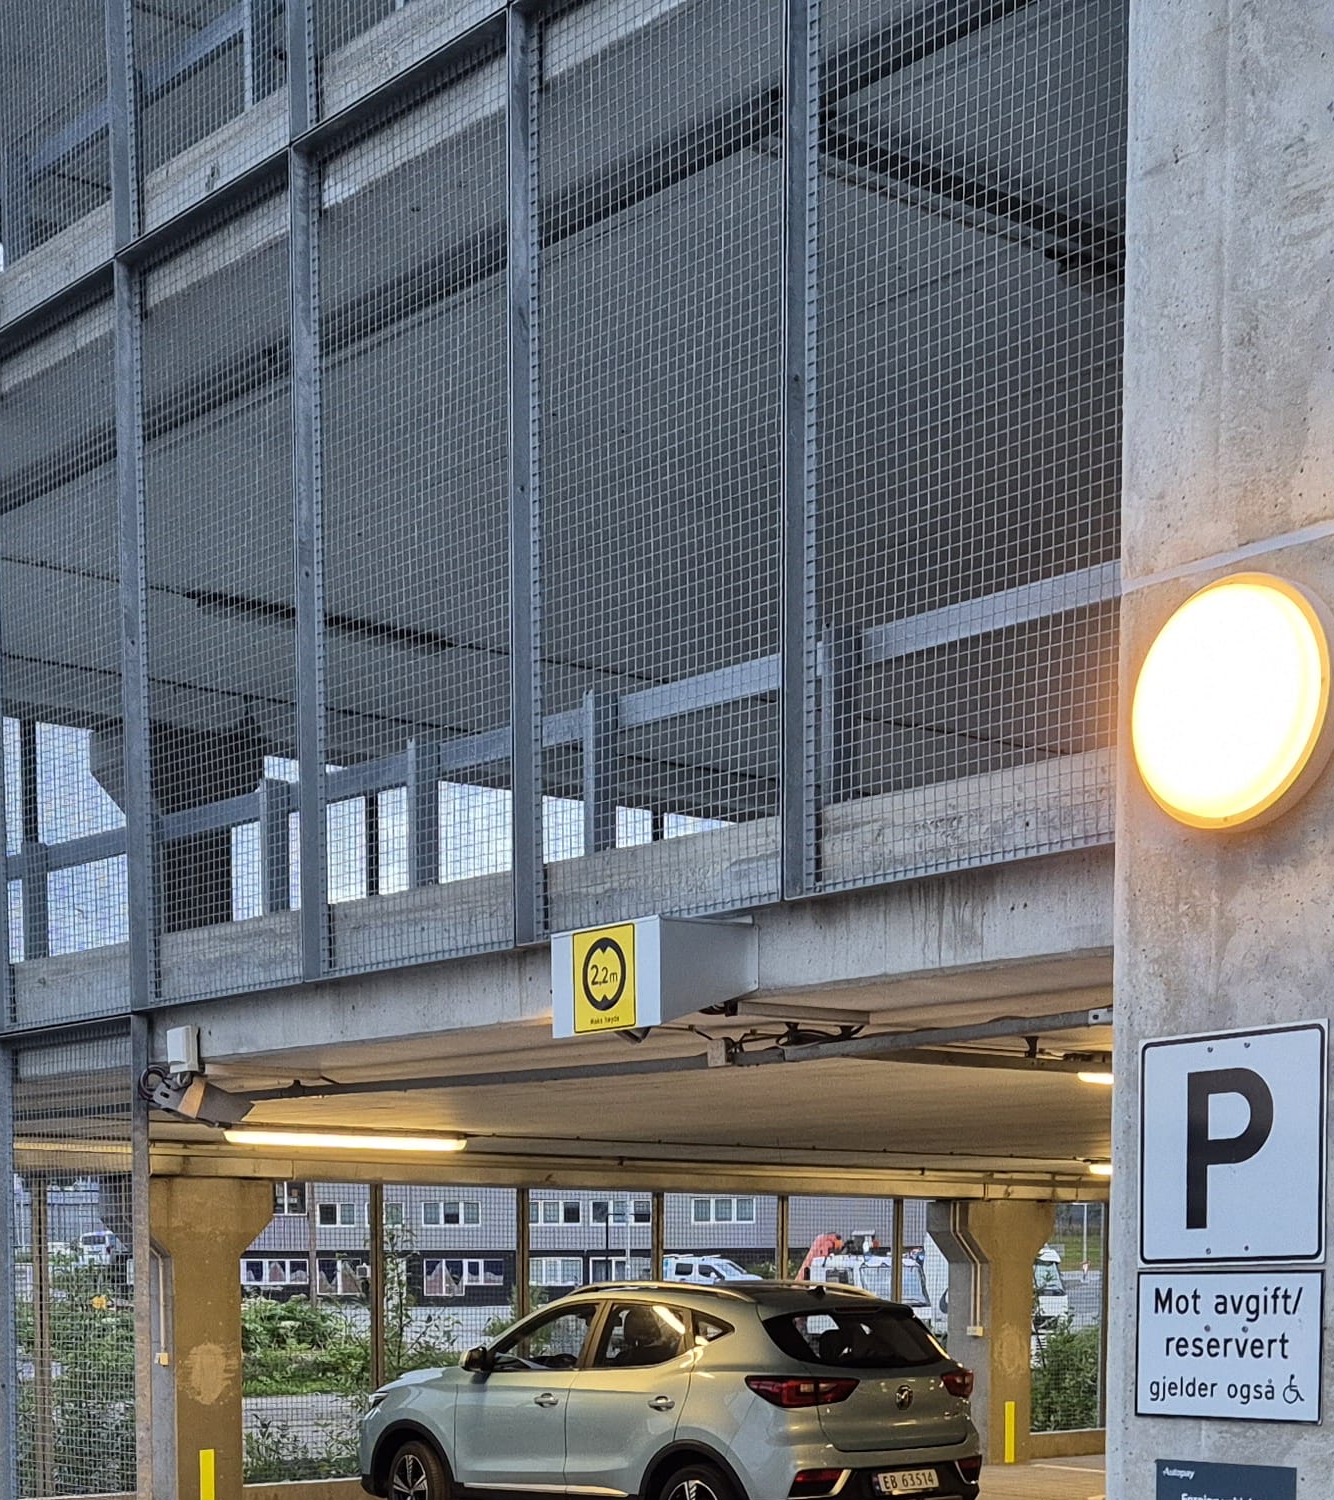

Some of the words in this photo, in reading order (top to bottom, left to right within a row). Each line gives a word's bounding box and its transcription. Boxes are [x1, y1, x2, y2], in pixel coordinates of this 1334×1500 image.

[1186, 1067, 1274, 1230] P
[1154, 1287, 1201, 1316] Mot
[1214, 1286, 1304, 1323] avgift/
[1165, 1332, 1290, 1360] reservert
[1149, 1376, 1218, 1403] gjelder
[1227, 1378, 1276, 1406] også
[883, 1475, 898, 1490] EB
[902, 1471, 934, 1488] 63514
[1163, 1467, 1196, 1480] Autopay
